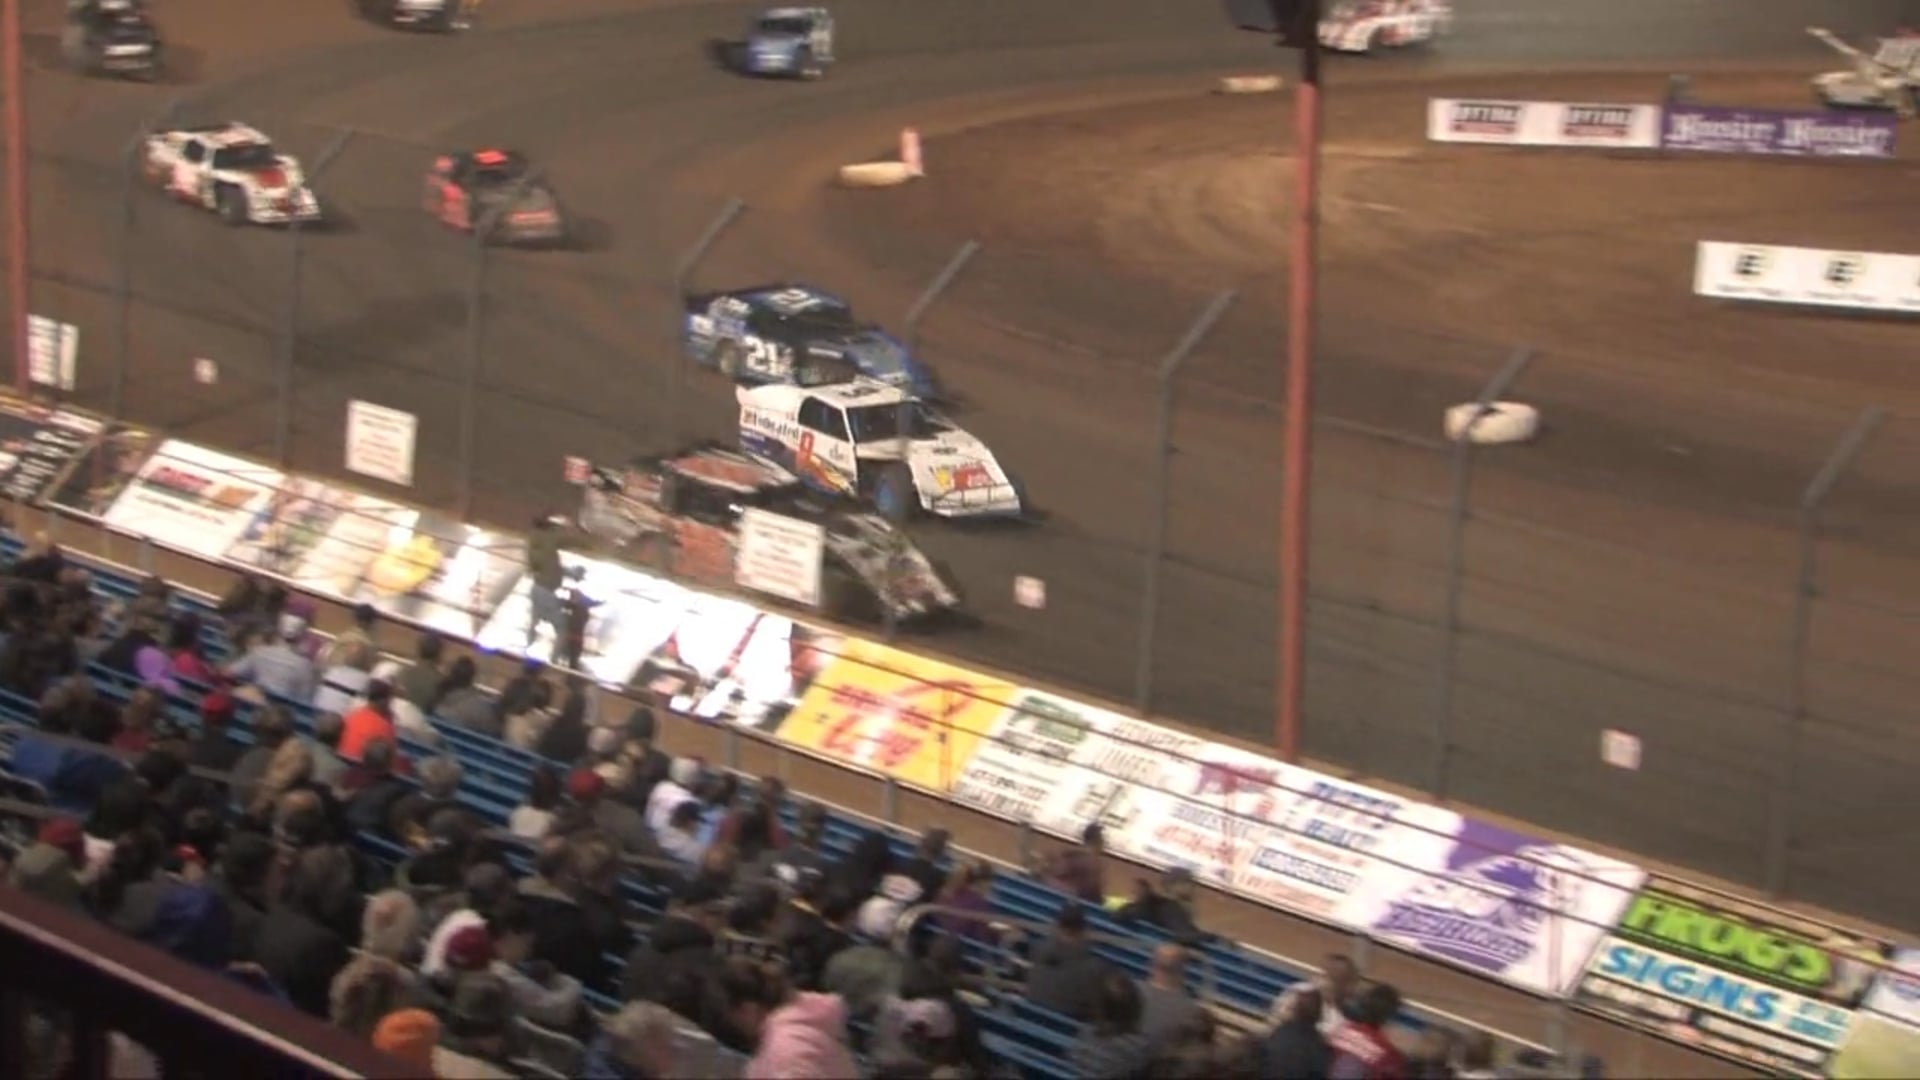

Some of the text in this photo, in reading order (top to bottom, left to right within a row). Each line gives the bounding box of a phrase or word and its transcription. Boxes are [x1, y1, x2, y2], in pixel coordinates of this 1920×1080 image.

[743, 334, 780, 376] 21
[1623, 894, 1833, 986] FROGS
[1601, 945, 1780, 1021] SIGNS
